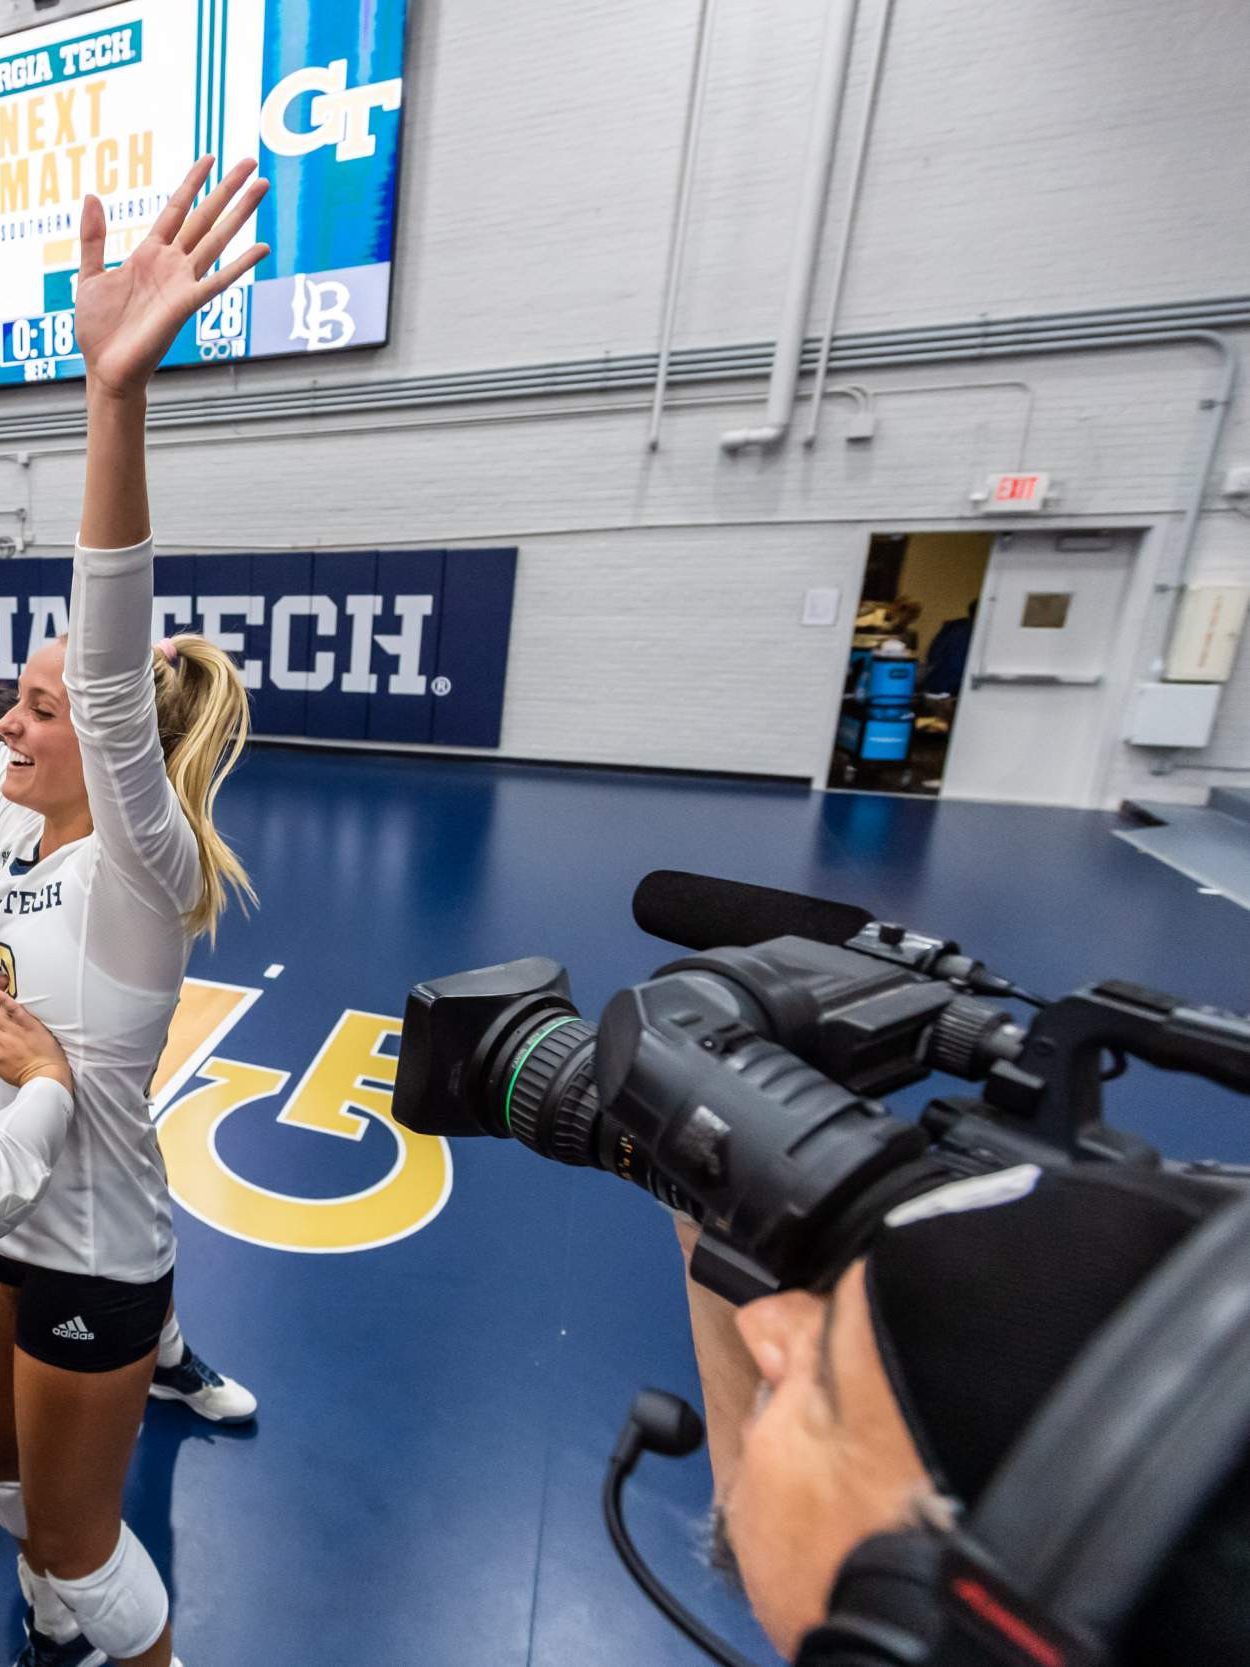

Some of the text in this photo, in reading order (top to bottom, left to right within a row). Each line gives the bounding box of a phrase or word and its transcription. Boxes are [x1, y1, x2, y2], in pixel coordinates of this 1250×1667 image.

[60, 29, 133, 76] TECH
[0, 131, 152, 214] MATCH
[0, 212, 72, 242] SOUTHERN
[109, 194, 170, 222] VERSIT
[12, 312, 74, 361] 0:18
[200, 287, 244, 341] 28
[996, 476, 1039, 500] EXIT
[3, 881, 63, 915] TECH
[52, 1327, 95, 1341] adidas
